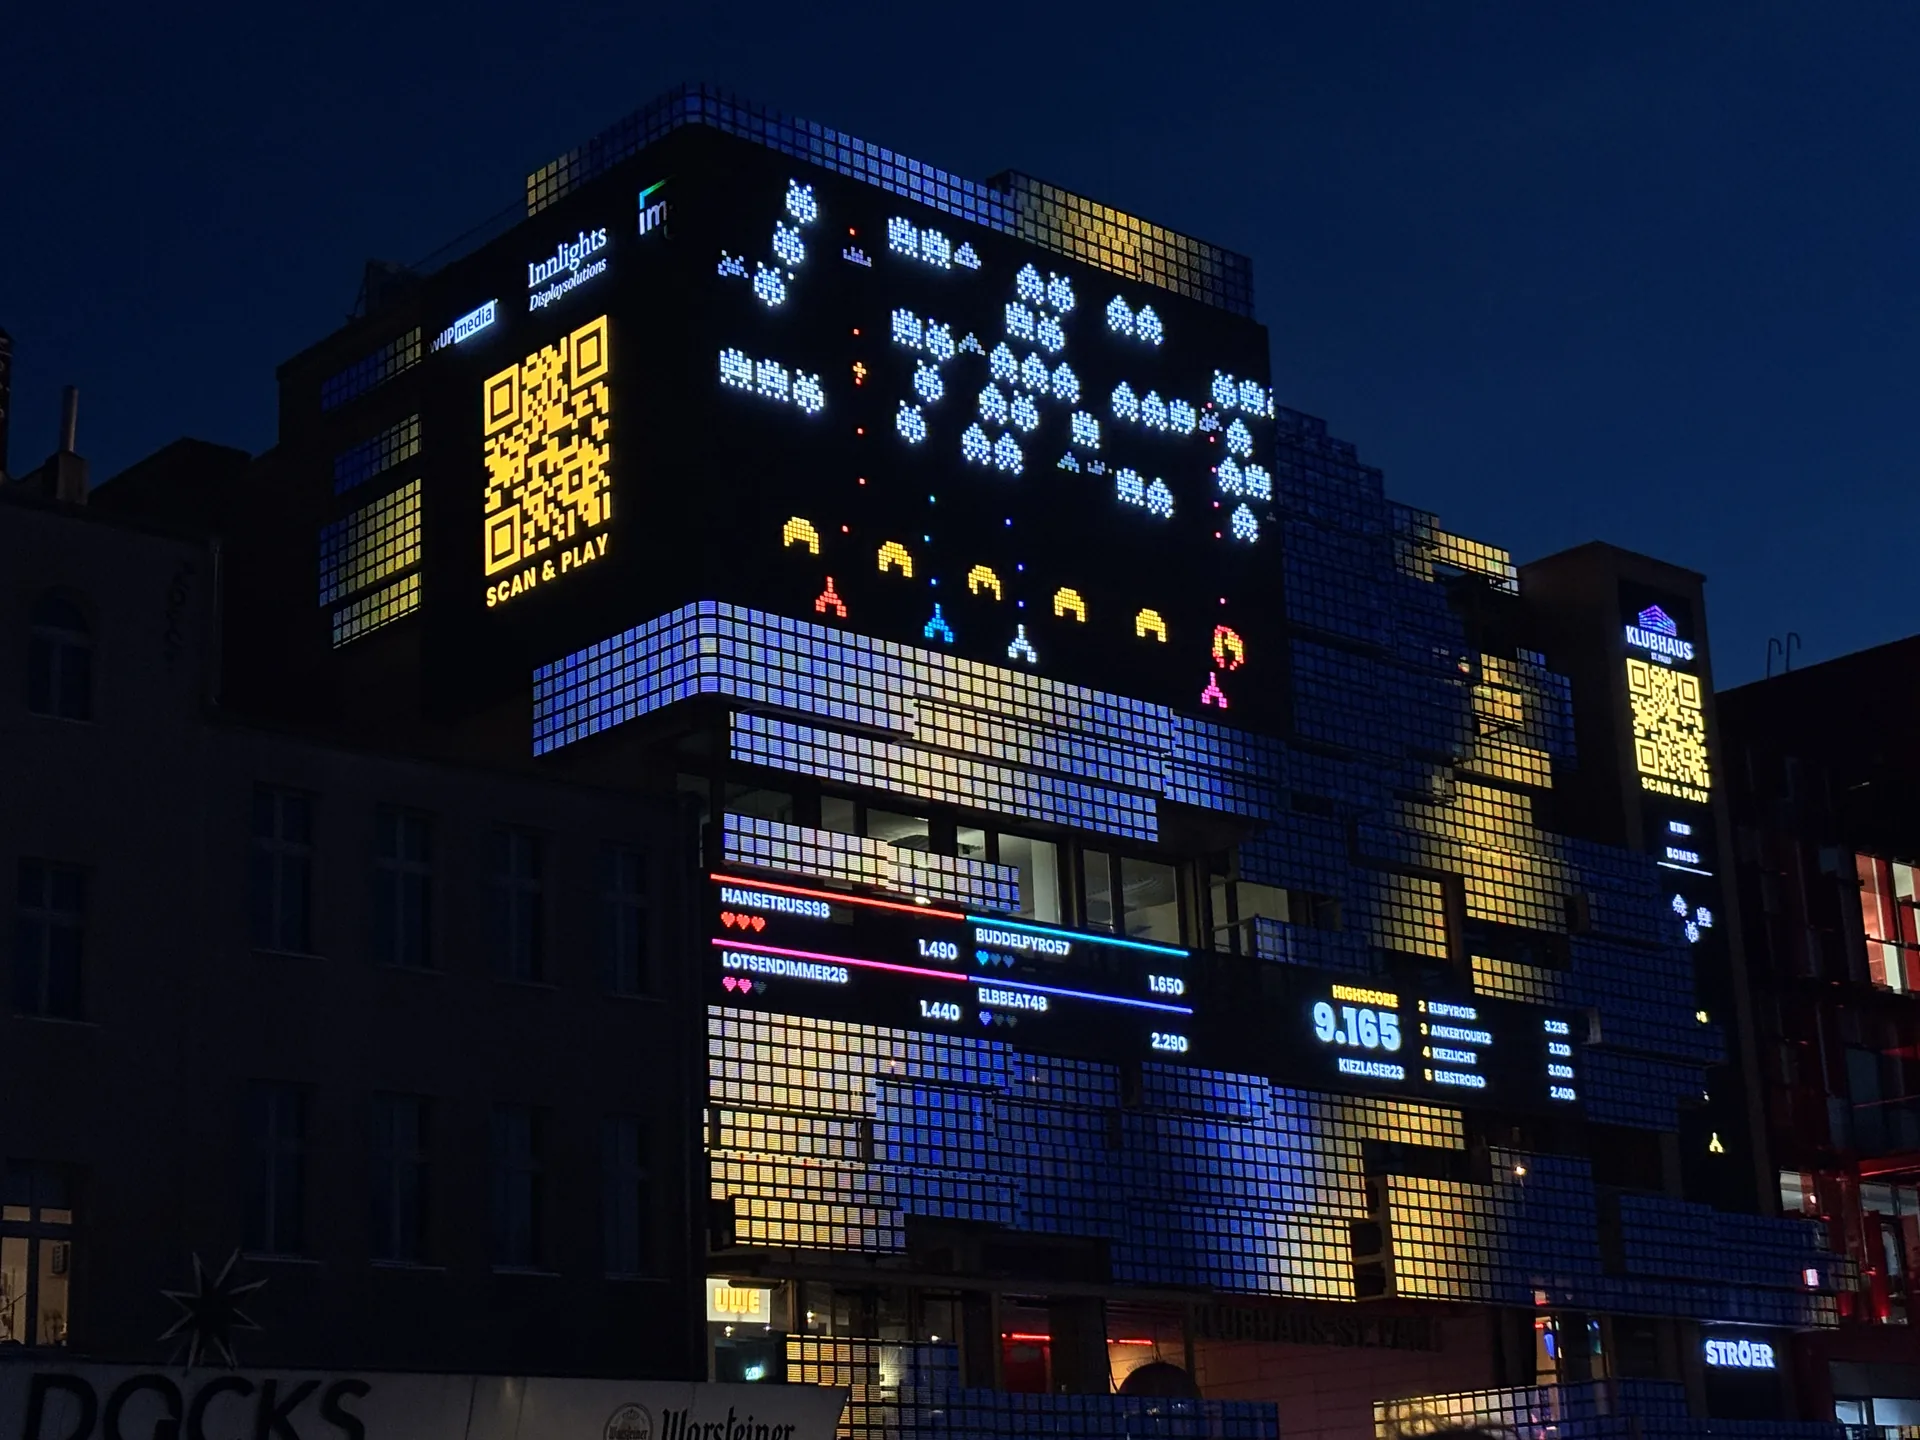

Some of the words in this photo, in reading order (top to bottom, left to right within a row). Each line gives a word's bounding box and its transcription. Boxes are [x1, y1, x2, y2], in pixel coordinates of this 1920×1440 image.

[528, 227, 607, 288] Innlights
[529, 258, 607, 311] Displaysolutions
[486, 566, 537, 607] SCAN
[541, 559, 556, 581] &
[561, 533, 608, 573] PLAY
[1625, 625, 1694, 660] KLUBHAUS
[1641, 776, 1671, 795] SCAN
[1672, 784, 1682, 797] &
[1682, 786, 1708, 803] PLAY
[1666, 846, 1699, 864] BOMBS
[721, 887, 830, 918] HANSETRUSS98
[918, 939, 958, 960] 1.490
[976, 927, 1070, 956] BUDDELPYRO57
[722, 951, 848, 983] LOTSENDIMMER26
[1149, 974, 1184, 995] 1.650
[1332, 984, 1398, 1008] HIGHSCORE
[920, 1000, 960, 1021] 1.440
[978, 987, 1047, 1012] ELBBEAT48
[1418, 1000, 1426, 1012] 2
[1428, 1001, 1477, 1020] ELBPYRO15
[1313, 1001, 1401, 1051] 9.165
[1420, 1022, 1428, 1035] 3
[1431, 1024, 1493, 1045] ANKERTOUR12
[1151, 1032, 1188, 1053] 2.290
[1422, 1045, 1431, 1058] 4
[1432, 1047, 1477, 1064] KIEZLICHT
[1338, 1057, 1405, 1079] KIEZLASER23
[1424, 1068, 1432, 1081] 5
[714, 1287, 760, 1314] UWE
[1705, 1339, 1775, 1368] STRÖER
